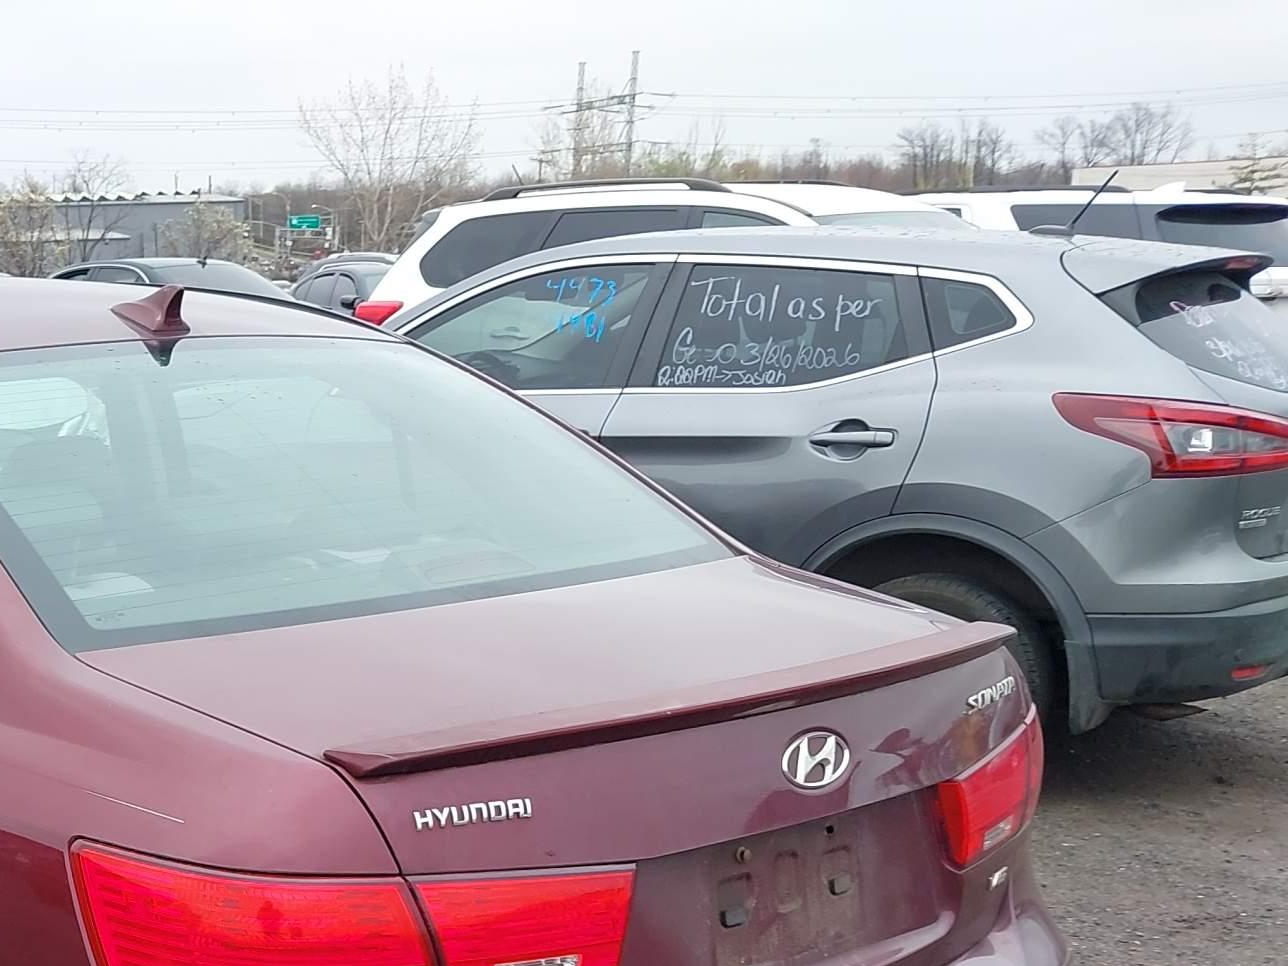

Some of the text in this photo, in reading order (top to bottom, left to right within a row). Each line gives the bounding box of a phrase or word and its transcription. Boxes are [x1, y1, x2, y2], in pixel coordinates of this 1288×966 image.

[546, 277, 616, 306] 4473
[691, 276, 883, 332] Total as per
[413, 798, 532, 831] HYUNDAI
